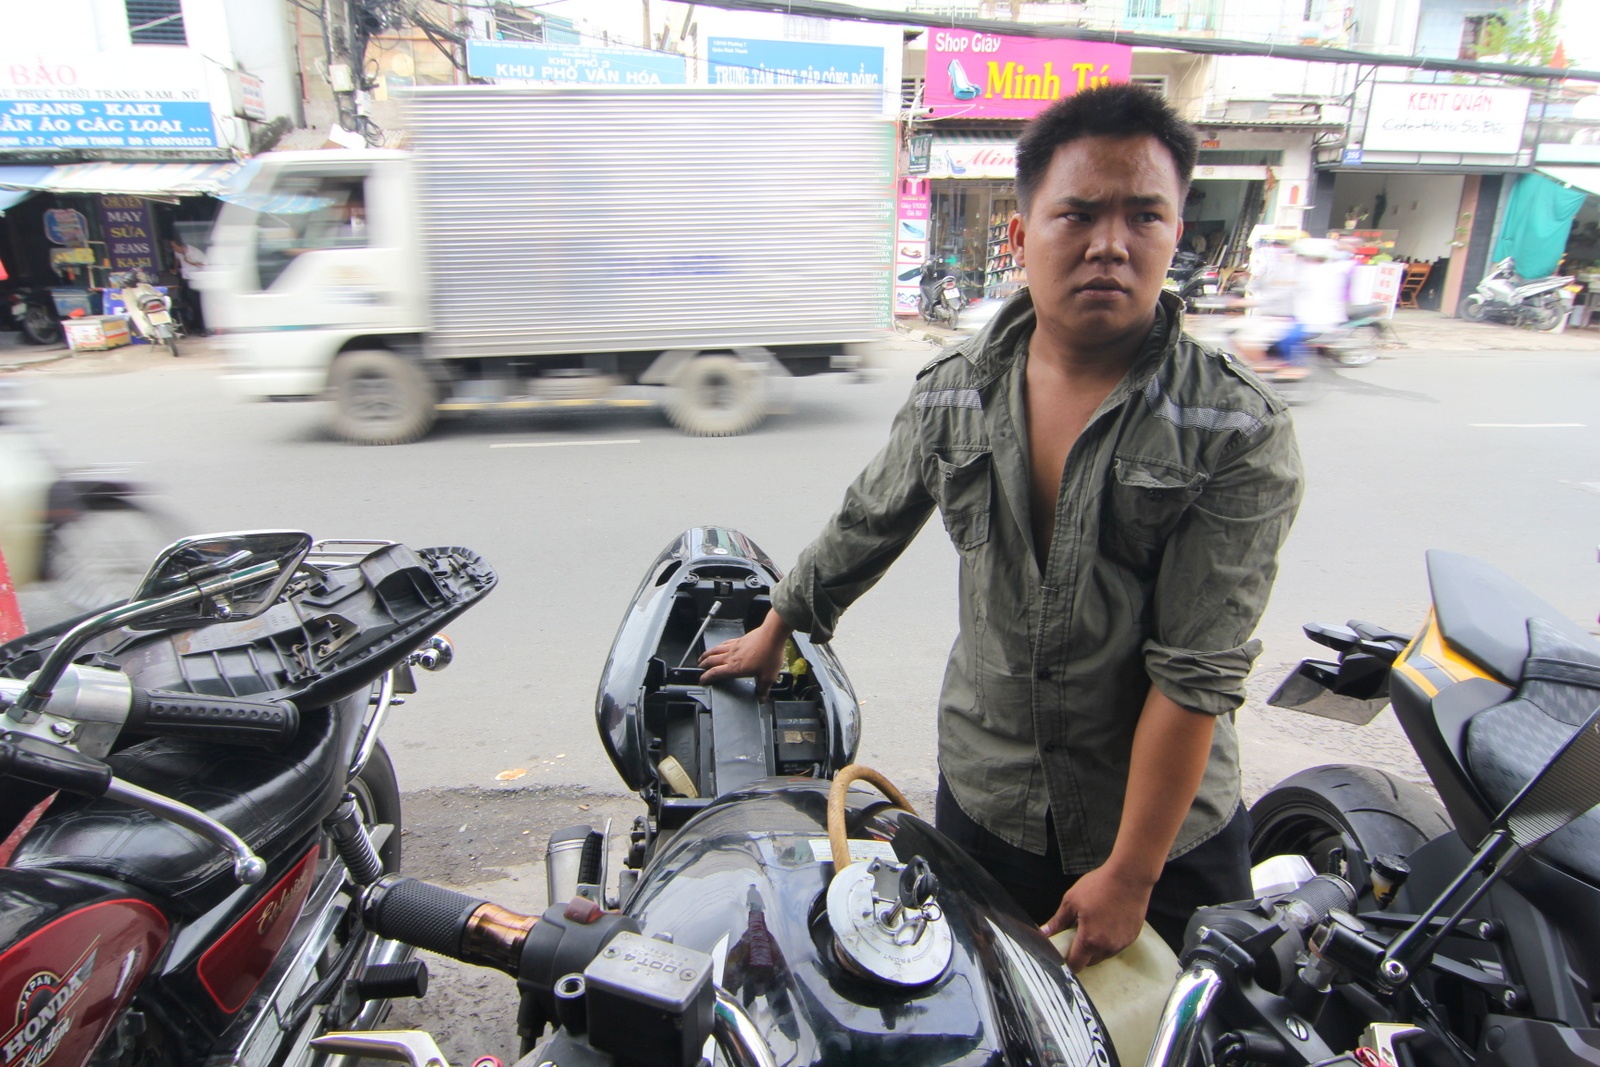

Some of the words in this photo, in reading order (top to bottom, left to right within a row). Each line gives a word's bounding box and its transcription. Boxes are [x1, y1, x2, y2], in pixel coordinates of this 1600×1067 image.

[935, 33, 968, 53] Shop
[9, 57, 77, 85] BẢO
[548, 57, 571, 66] KHU
[602, 60, 610, 68] 3
[496, 63, 534, 77] KHU
[585, 67, 620, 82] VĂN
[626, 69, 661, 84] HÓA
[714, 66, 749, 84] TRUNG
[984, 61, 1060, 100] Minh
[10, 103, 85, 115] JEANS
[104, 103, 162, 116] KAKI
[1408, 92, 1448, 110] KENT
[39, 116, 72, 131] ÁO
[77, 116, 125, 131] CÁC
[129, 119, 183, 134] LOẠI
[957, 148, 1014, 166] Min
[106, 211, 142, 222] MAY
[113, 243, 150, 254] JEANS
[637, 958, 678, 974] DOT
[20, 975, 51, 1010] JAPAN
[3, 967, 84, 1064] HONDA
